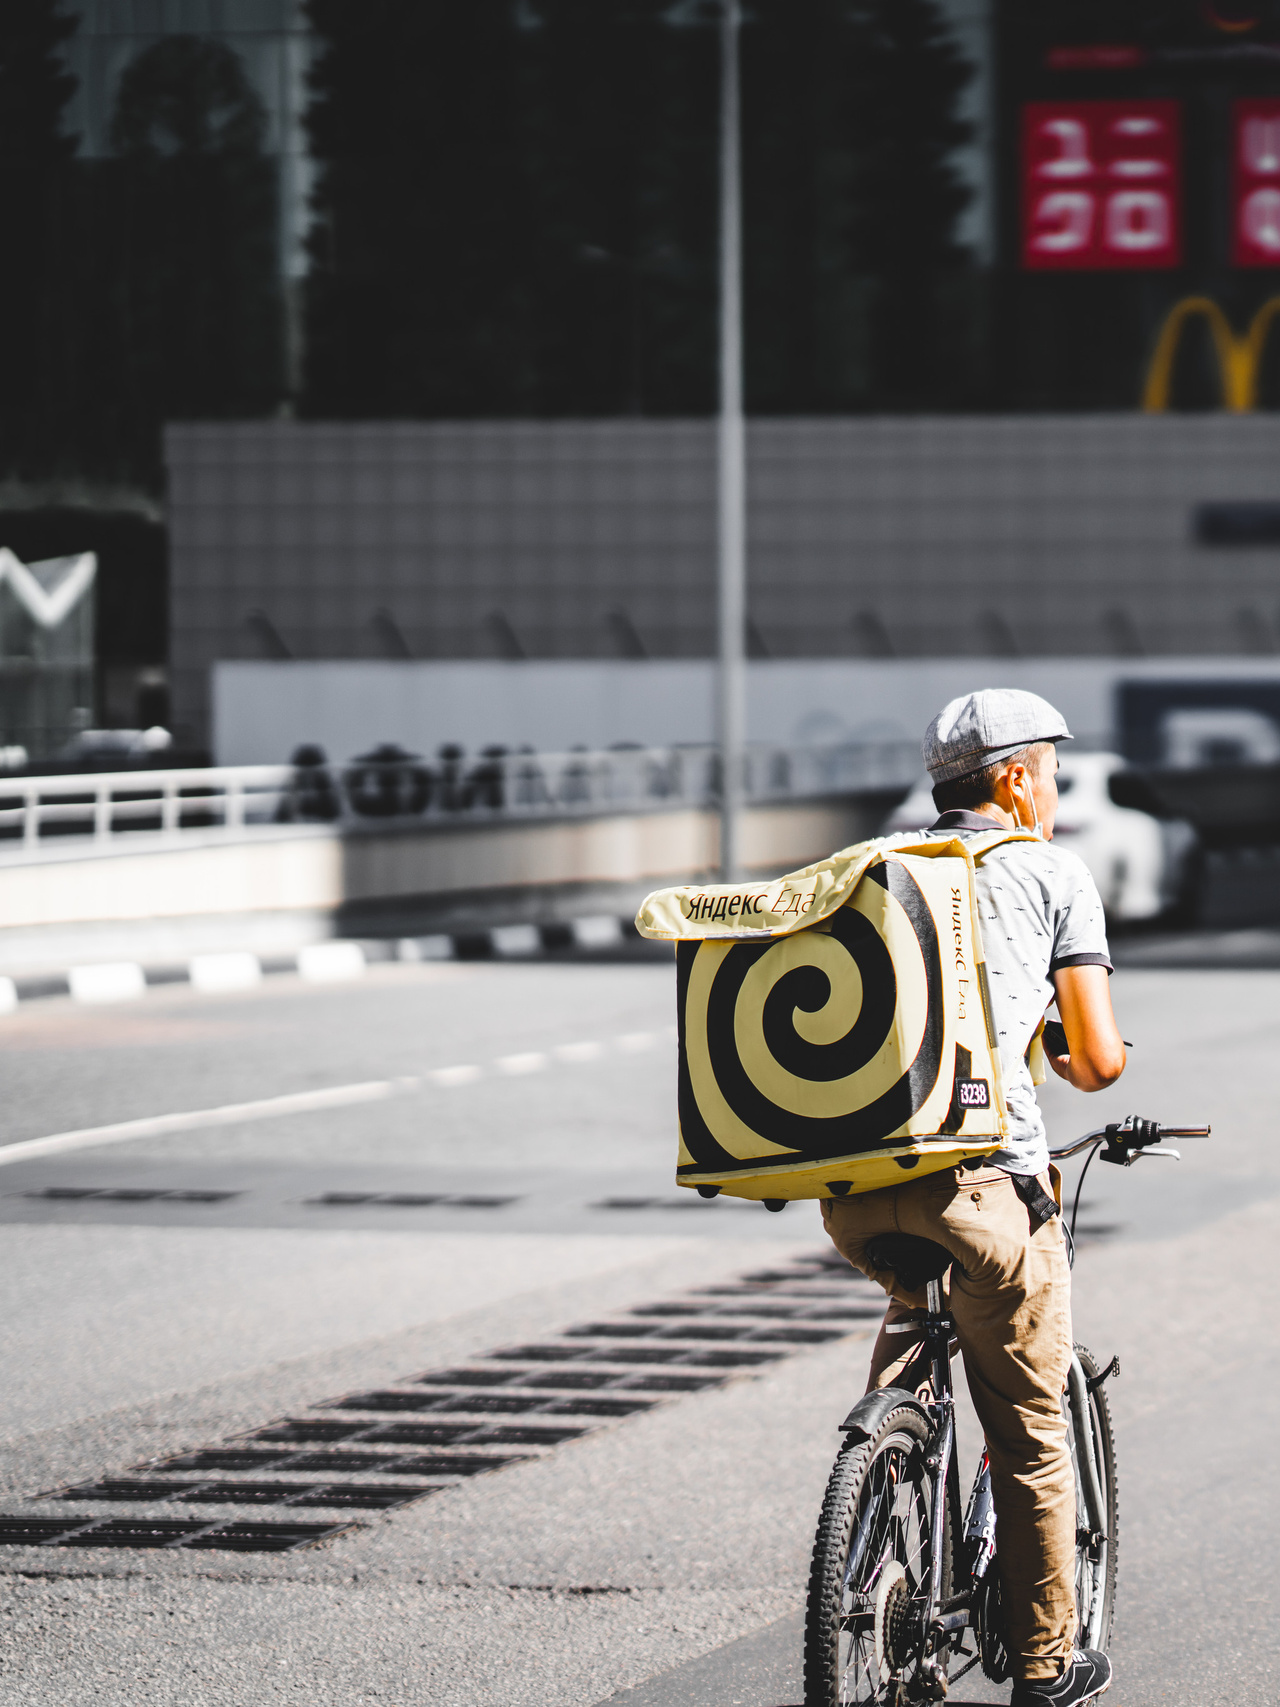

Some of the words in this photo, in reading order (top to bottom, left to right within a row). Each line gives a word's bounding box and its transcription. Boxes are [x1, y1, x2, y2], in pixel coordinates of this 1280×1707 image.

[685, 893, 768, 922] Яндекс
[771, 888, 816, 916] Еда
[951, 887, 966, 971] Яндекс
